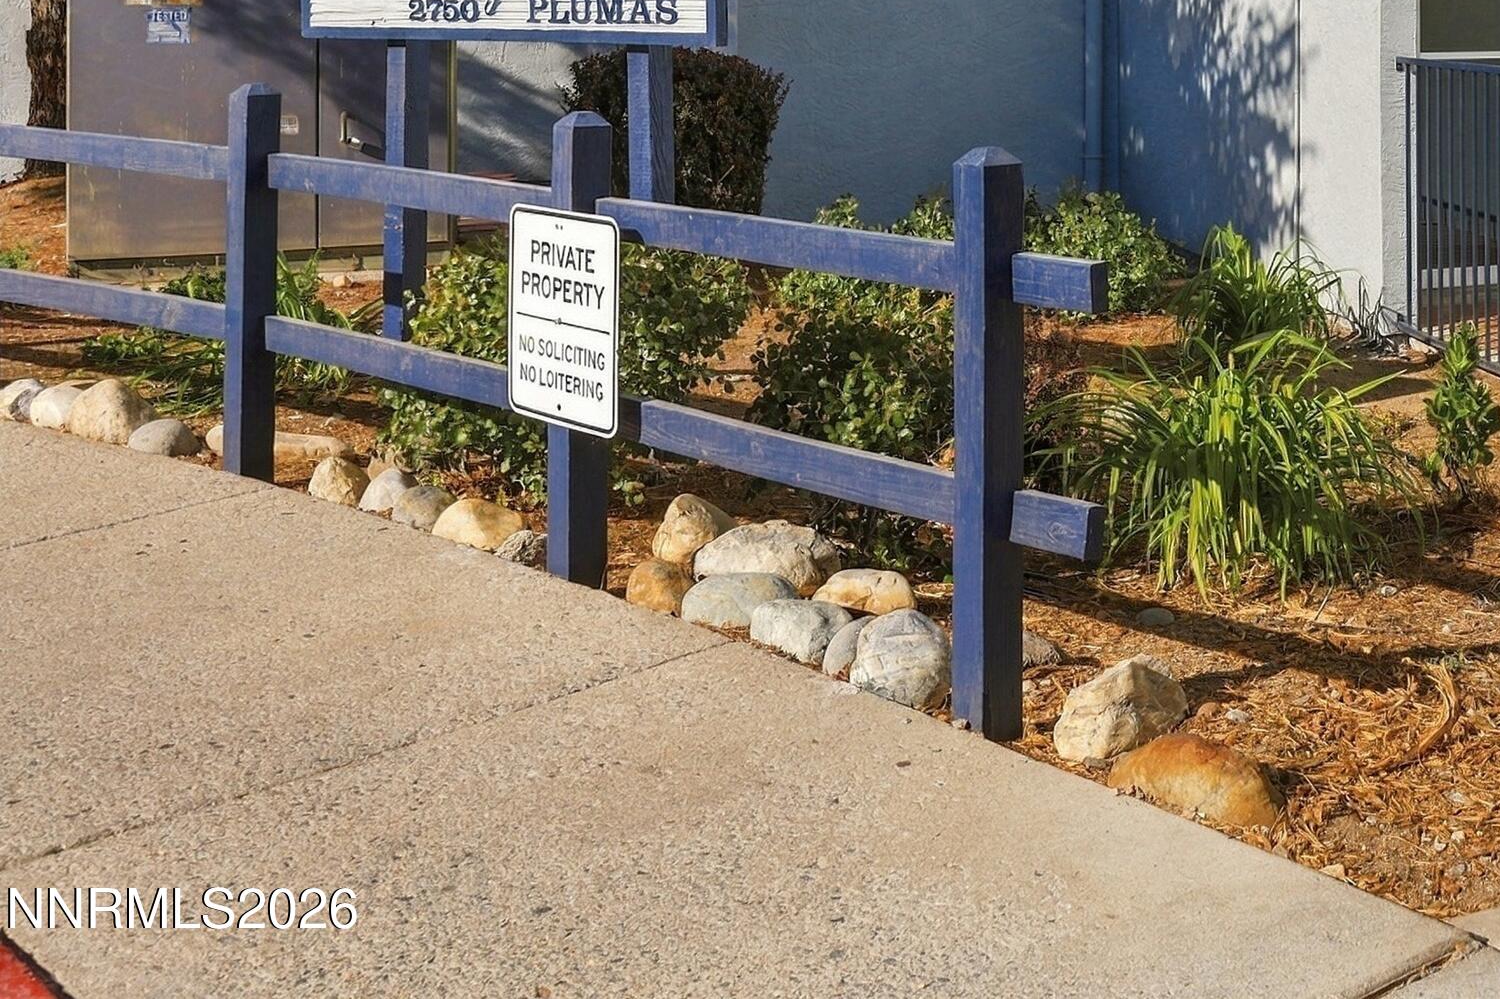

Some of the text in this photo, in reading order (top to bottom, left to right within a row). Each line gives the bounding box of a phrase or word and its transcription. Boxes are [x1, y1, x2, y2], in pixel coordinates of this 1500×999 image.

[530, 239, 596, 274] PRIVATE
[521, 270, 605, 310] PROPERTY
[519, 334, 605, 371] NO SOLICITING
[520, 363, 604, 402] NO LOITERING
